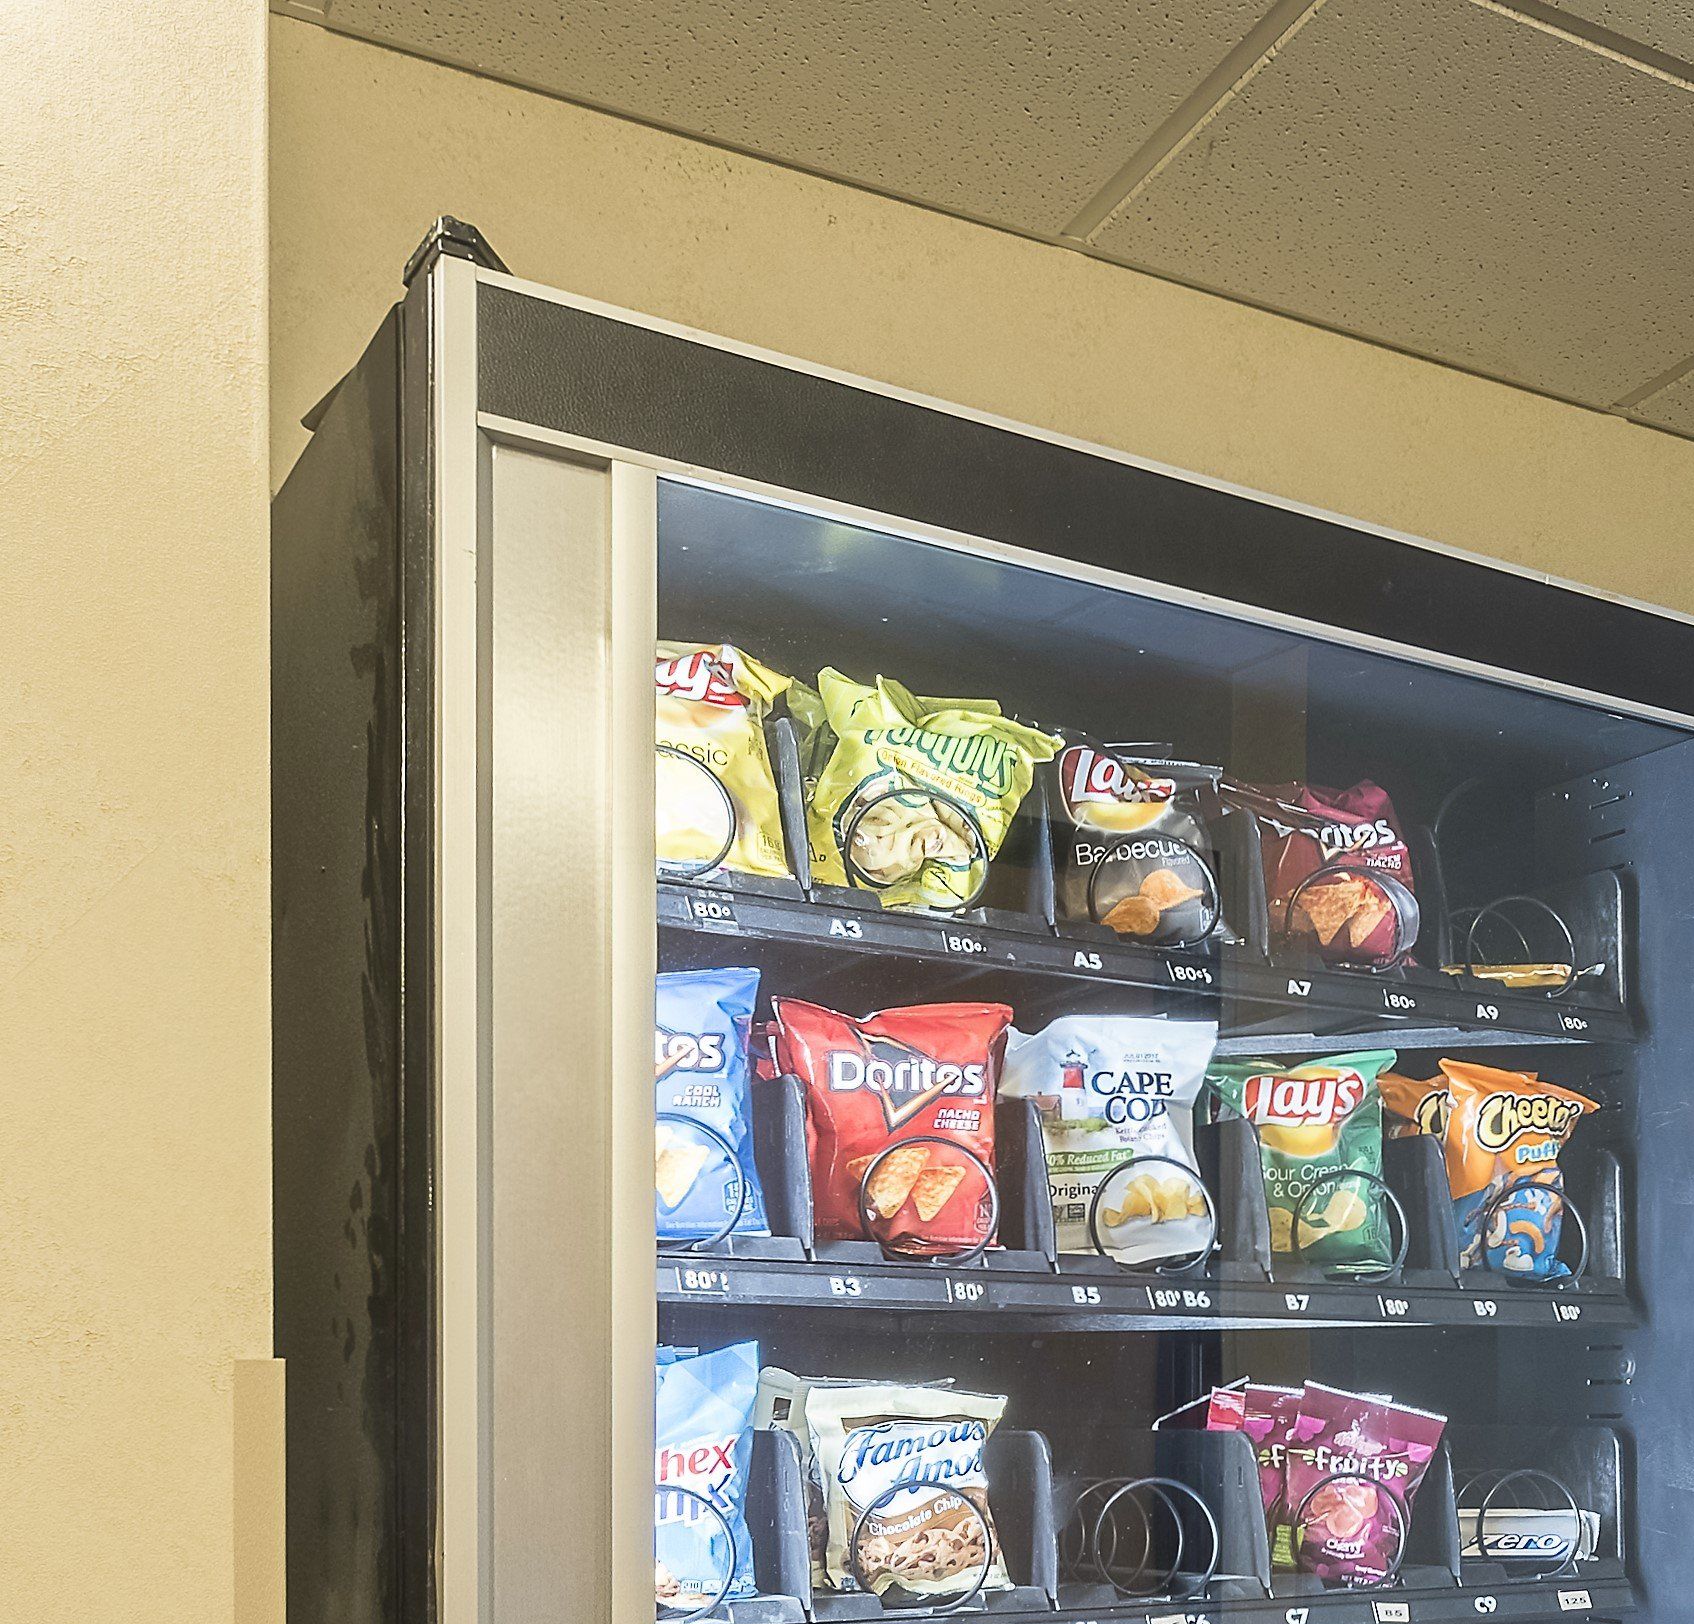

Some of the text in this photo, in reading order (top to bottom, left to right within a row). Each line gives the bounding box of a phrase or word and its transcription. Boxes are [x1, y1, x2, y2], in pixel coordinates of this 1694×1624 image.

[955, 784, 982, 804] Rings
[829, 919, 863, 938] A3
[1074, 950, 1103, 971] A5
[1287, 979, 1312, 997] A7
[1477, 1003, 1500, 1020] A9
[830, 1053, 986, 1092] Doritos
[685, 1084, 719, 1098] COOL
[1091, 1072, 1174, 1097] CAPE
[673, 1094, 720, 1107] RANCH
[1253, 1068, 1364, 1127] Lay's
[937, 1108, 980, 1121] NACHO
[1105, 1096, 1166, 1124] COD
[933, 1119, 980, 1131] CHEESE
[1478, 1092, 1582, 1152] Cheeto
[1067, 1151, 1109, 1166] Reduced
[1273, 1181, 1285, 1198] &
[830, 1277, 862, 1297] B3
[1072, 1287, 1100, 1304] B5
[1183, 1291, 1211, 1309] B6
[1286, 1294, 1310, 1311] B7
[1474, 1300, 1498, 1317] B9
[659, 1438, 735, 1481] hex
[838, 1421, 987, 1483] Famous
[868, 1496, 963, 1537] Chocolate Chip
[1475, 1596, 1498, 1614] C9
[1565, 1595, 1588, 1607] 125
[1384, 1608, 1404, 1619] 85
